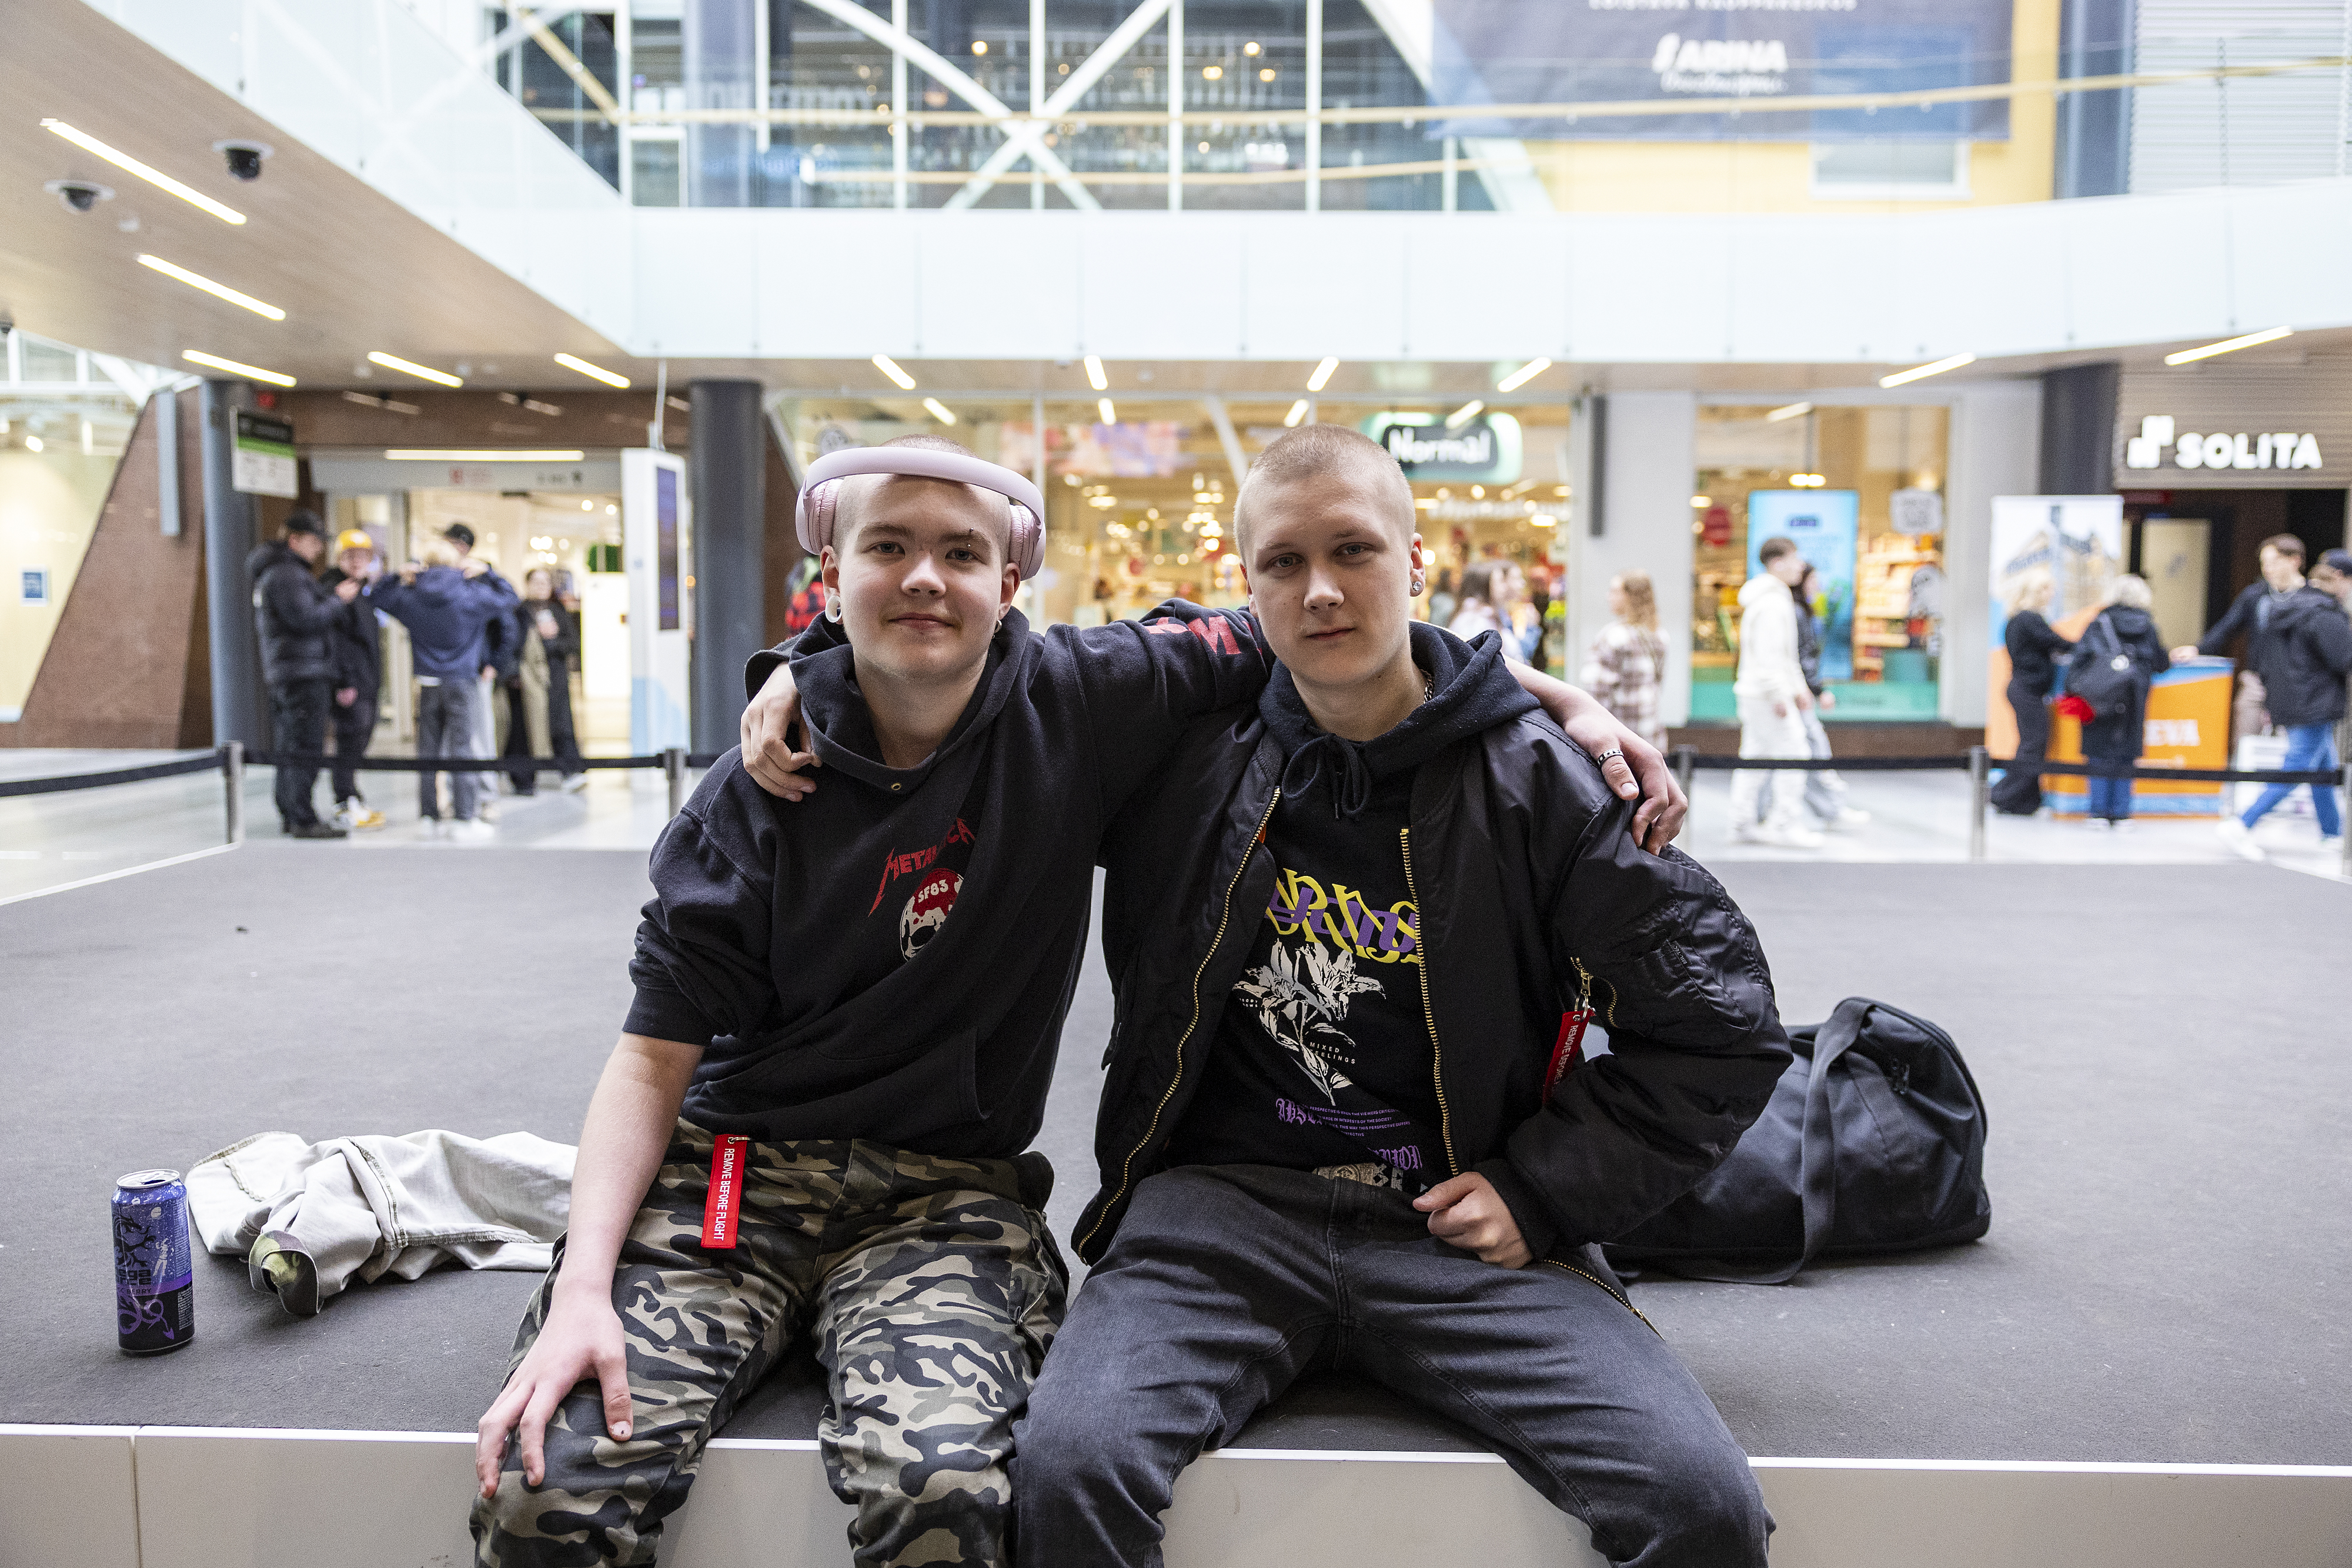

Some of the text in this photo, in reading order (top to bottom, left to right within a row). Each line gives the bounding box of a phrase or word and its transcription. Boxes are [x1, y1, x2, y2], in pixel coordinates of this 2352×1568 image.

[1388, 427, 1491, 463] Normal
[2175, 432, 2322, 469] SOLITA
[918, 879, 948, 904] SF83
[1309, 1042, 1339, 1053] MIXED
[1562, 1025, 1579, 1054] REMOVE
[1310, 1049, 1355, 1064] EELINGS
[713, 1148, 735, 1241] REMOVE BEFORE FLIGHT
